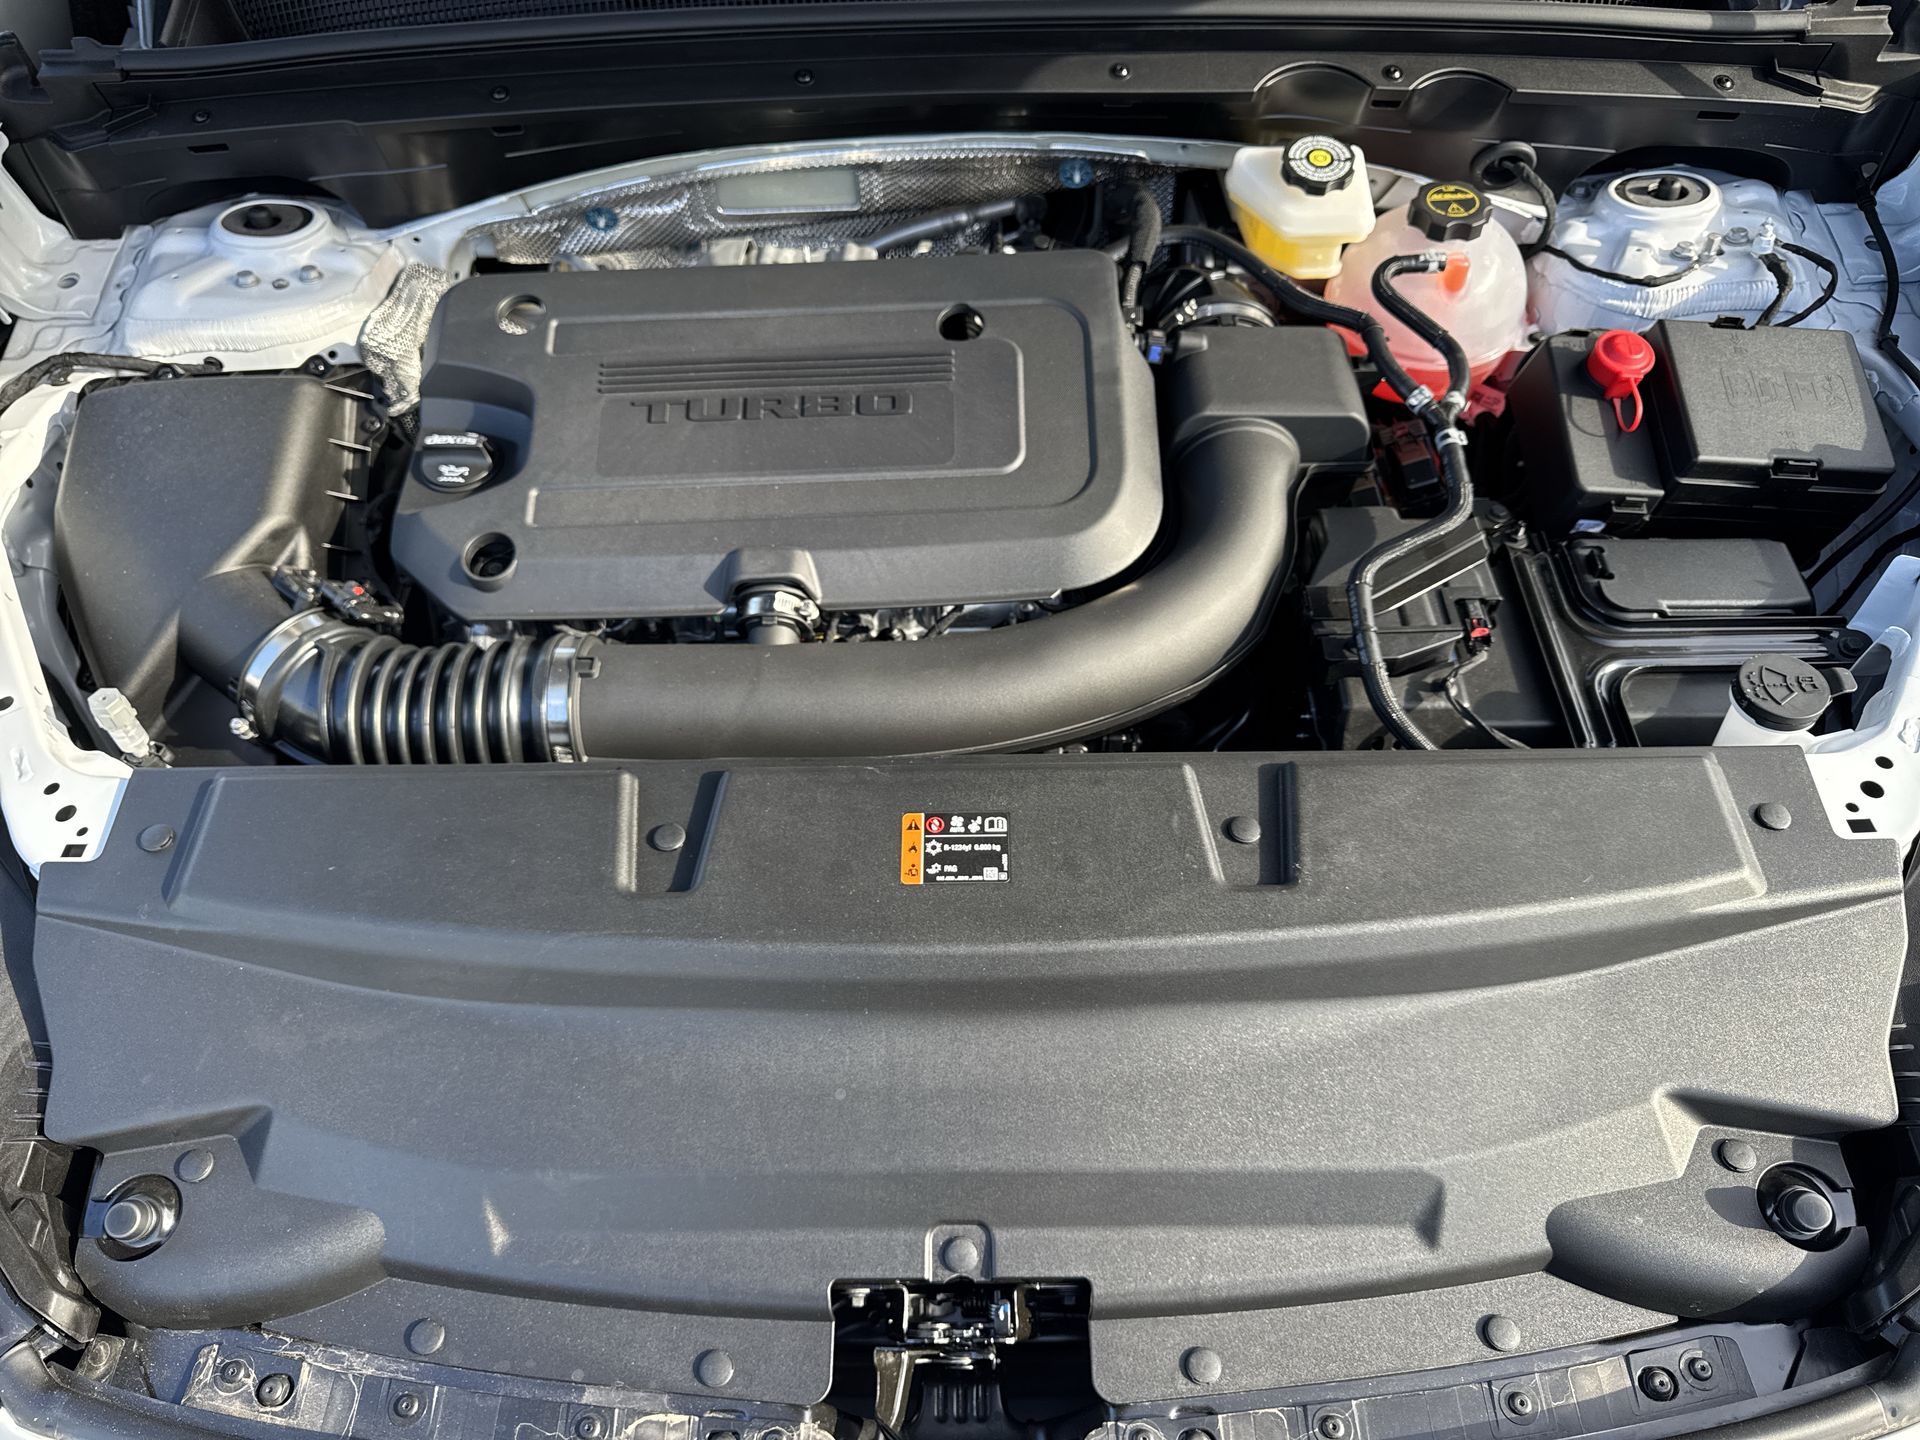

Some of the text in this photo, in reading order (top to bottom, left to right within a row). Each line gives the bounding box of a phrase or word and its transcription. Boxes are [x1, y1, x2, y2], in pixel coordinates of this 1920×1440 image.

[629, 392, 914, 424] TURBO
[424, 433, 478, 445] dexos
[992, 844, 1001, 852] kg
